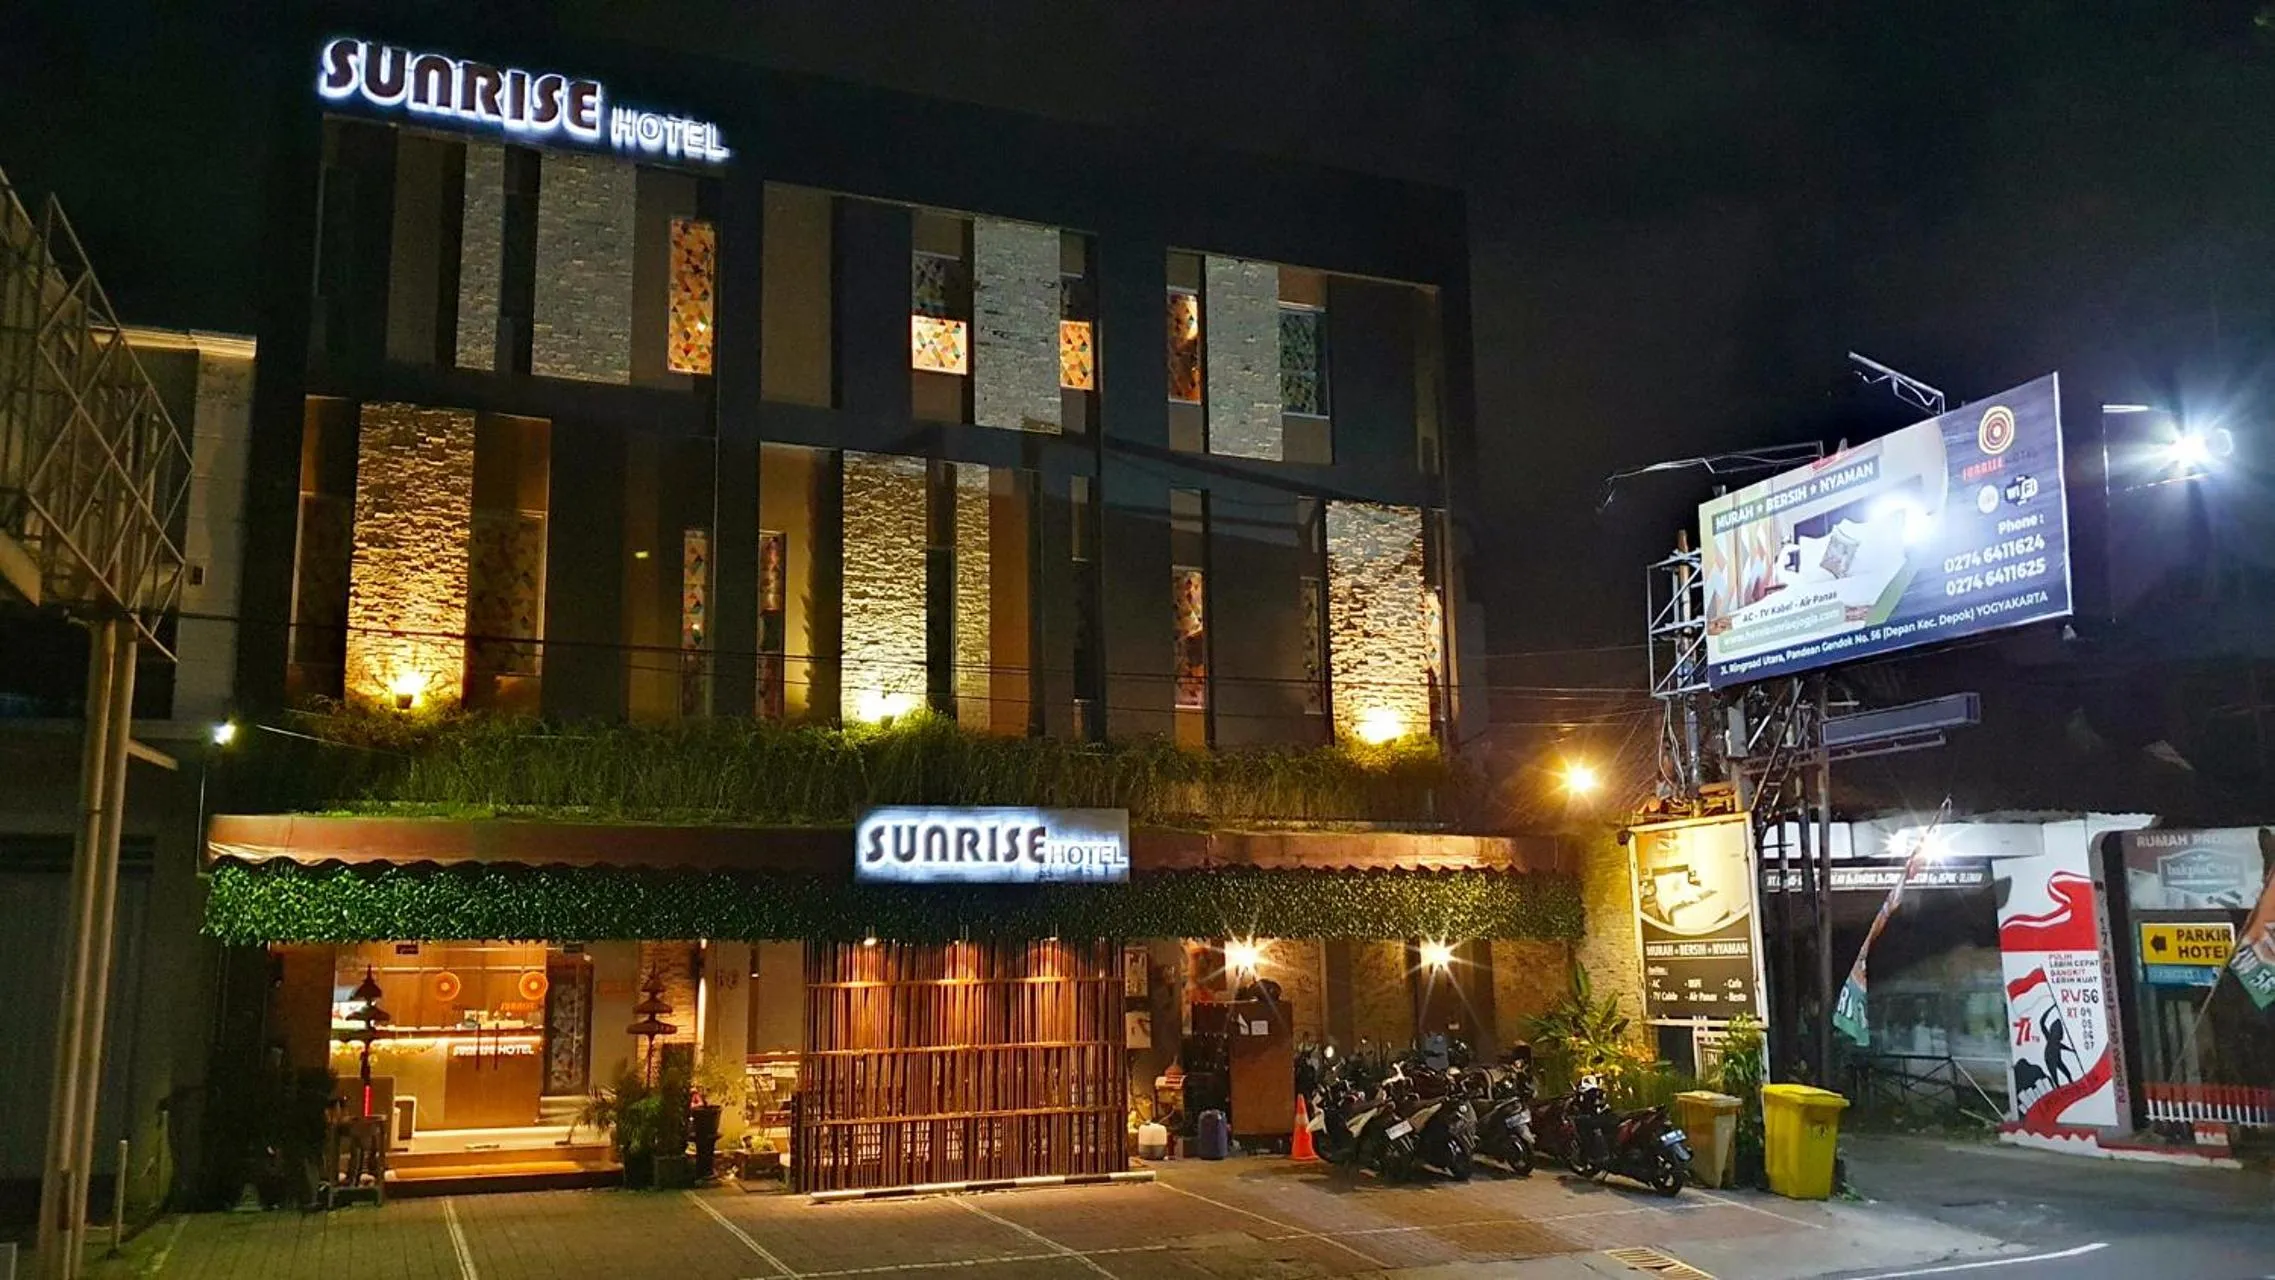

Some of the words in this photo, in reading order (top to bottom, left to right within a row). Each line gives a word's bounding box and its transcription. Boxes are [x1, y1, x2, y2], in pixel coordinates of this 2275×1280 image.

[321, 38, 602, 133] SUNRISE
[611, 107, 730, 160] HOTEL
[1715, 506, 1754, 530] MURAH
[1766, 488, 1808, 512] BERSIH
[1819, 463, 1874, 491] NYAMAN
[1998, 515, 2038, 534] Phone
[1944, 550, 1980, 573] 0274
[1983, 533, 2045, 563] 6411624
[1946, 574, 1984, 596] 0274
[1985, 557, 2046, 586] 6411625
[1976, 590, 2048, 616] YOGYAKARTA
[865, 825, 1046, 863] SUNRISE
[1050, 844, 1127, 866] HOTEL
[2136, 834, 2188, 848] RUMAH
[2176, 928, 2232, 943] PARKIR
